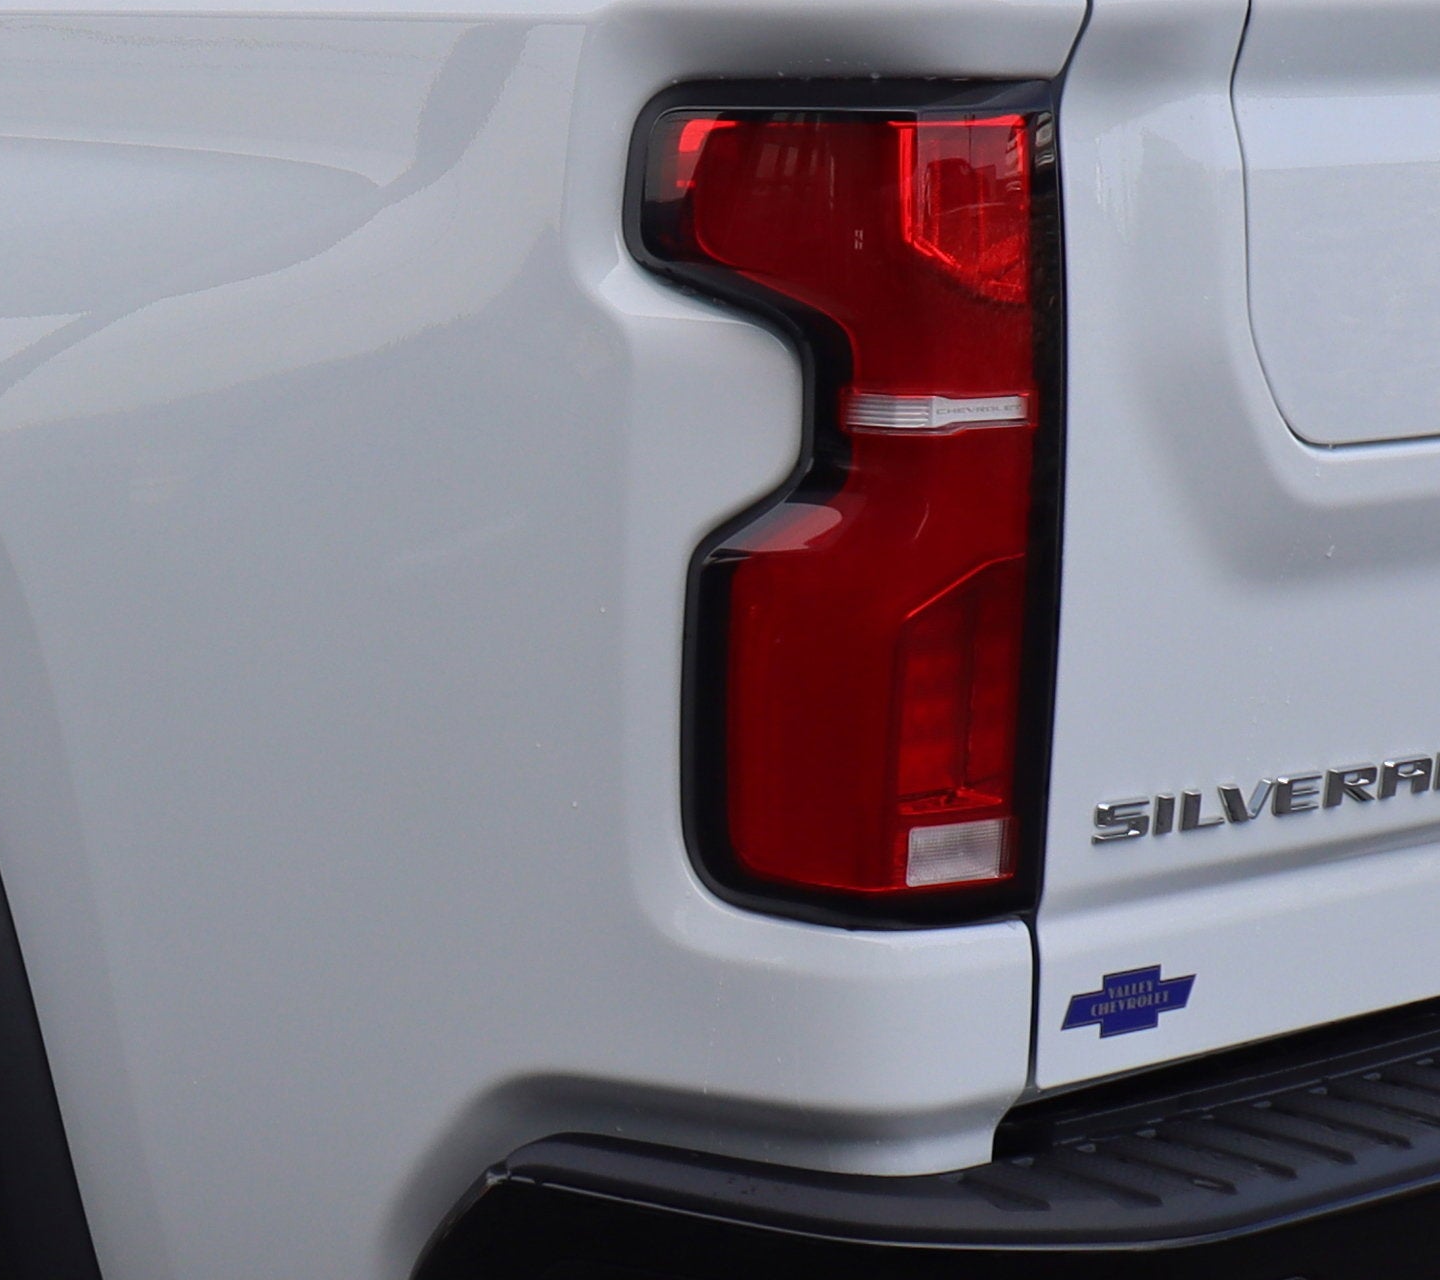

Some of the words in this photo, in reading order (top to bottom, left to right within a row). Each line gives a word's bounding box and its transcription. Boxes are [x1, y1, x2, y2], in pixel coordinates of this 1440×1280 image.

[936, 403, 1023, 416] CHEVROLET
[1108, 980, 1154, 999] VALLEY
[1090, 990, 1169, 1017] CHEVROLET
